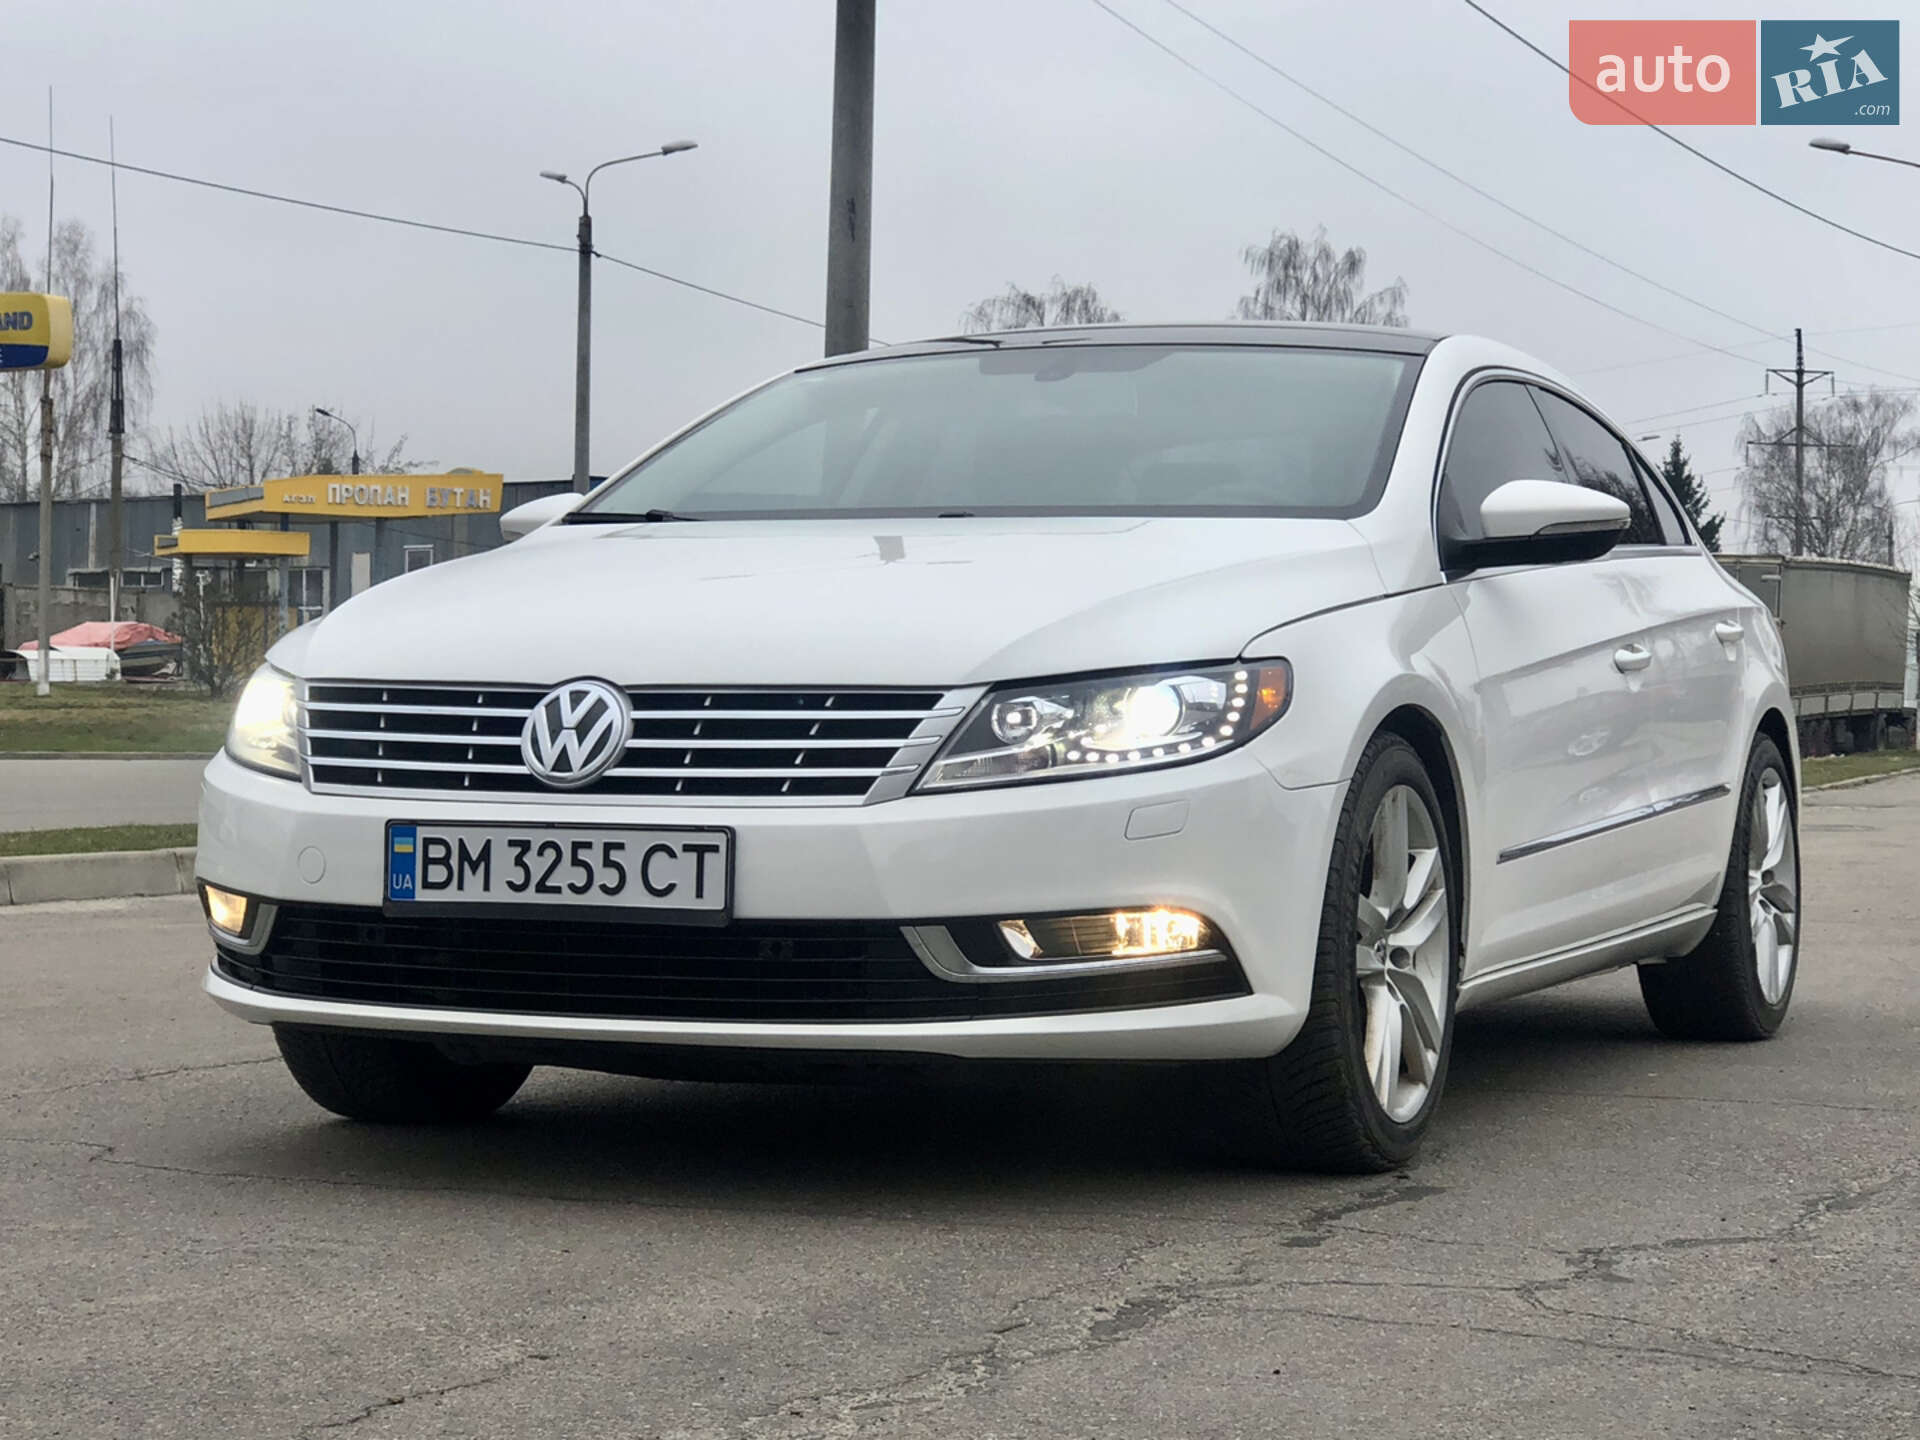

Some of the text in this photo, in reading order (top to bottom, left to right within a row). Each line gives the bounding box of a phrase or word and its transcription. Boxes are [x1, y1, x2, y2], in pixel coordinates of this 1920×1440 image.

[327, 482, 410, 507] ПРОПАН
[425, 486, 492, 509] БУТАН
[421, 836, 720, 899] BM 3255 CT
[393, 876, 413, 891] UA
